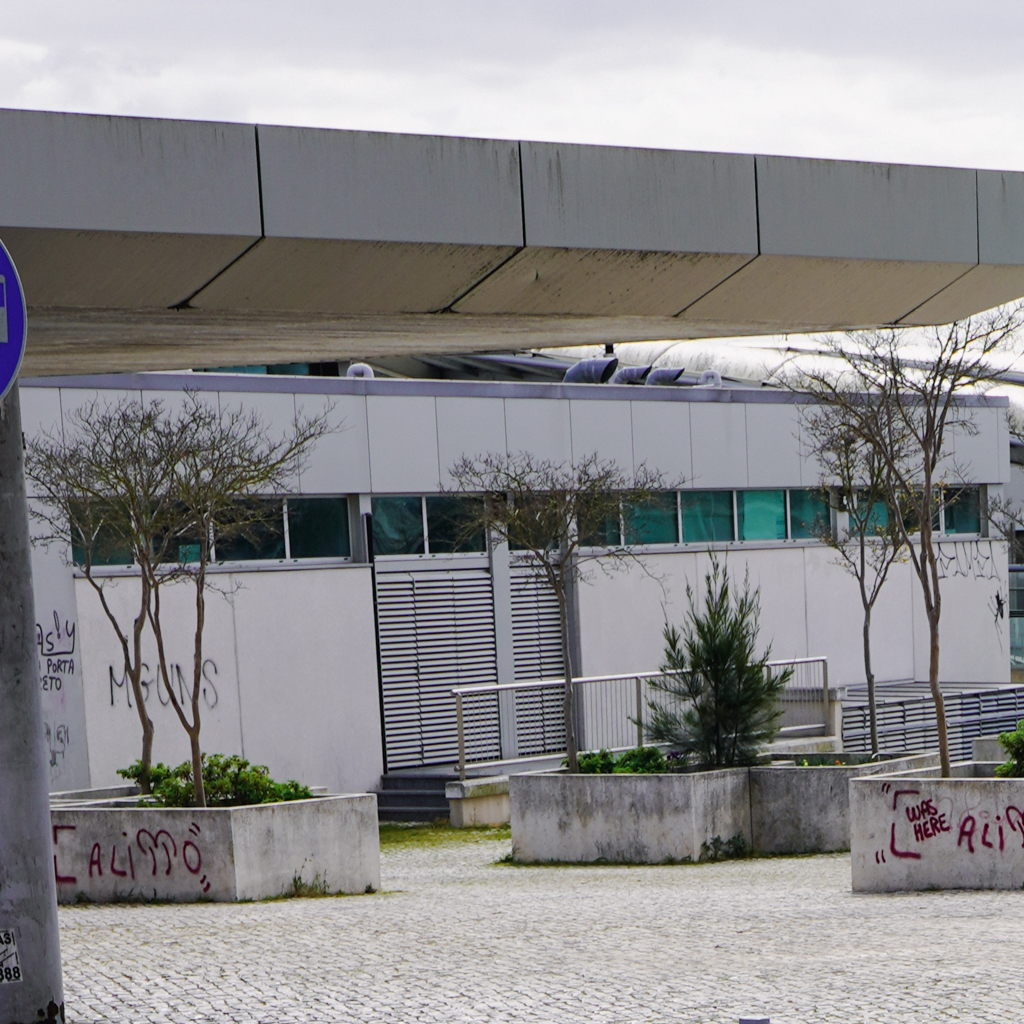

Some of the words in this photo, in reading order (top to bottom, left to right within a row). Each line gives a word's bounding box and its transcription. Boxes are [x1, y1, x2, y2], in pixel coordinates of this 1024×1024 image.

[47, 658, 75, 675] PORTA
[40, 675, 62, 691] ETO
[906, 799, 938, 822] WAS
[914, 813, 951, 842] HERE
